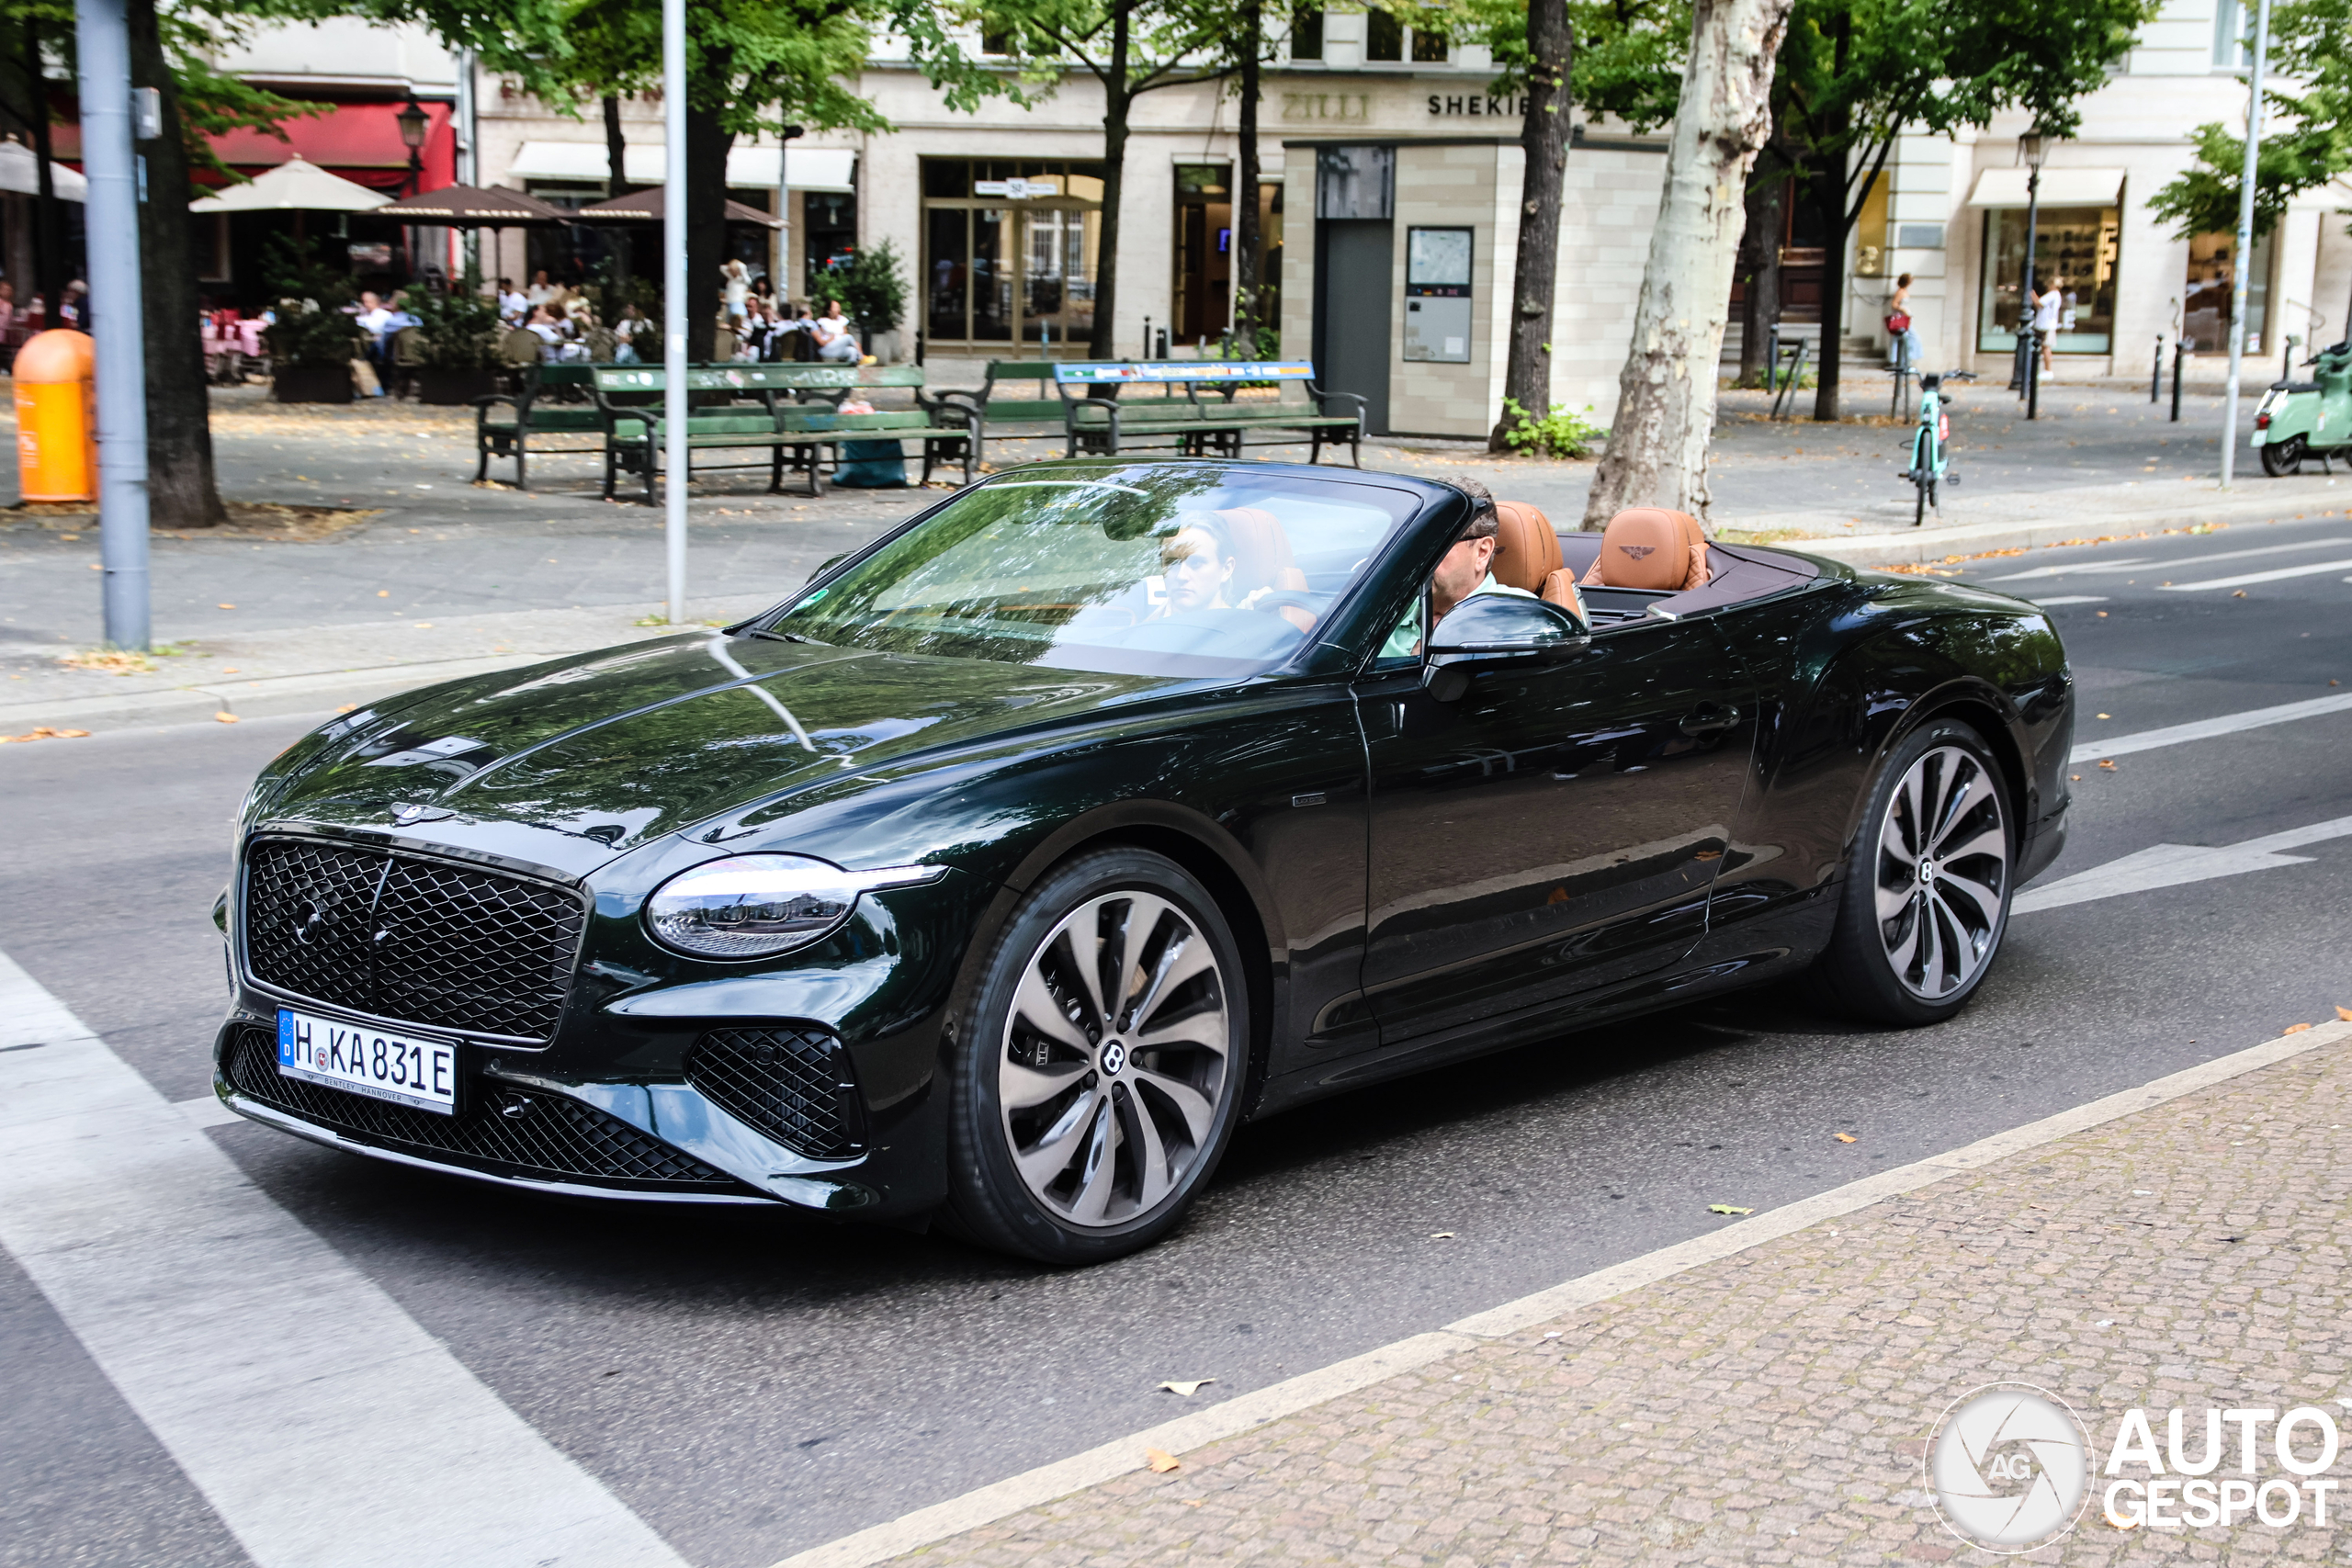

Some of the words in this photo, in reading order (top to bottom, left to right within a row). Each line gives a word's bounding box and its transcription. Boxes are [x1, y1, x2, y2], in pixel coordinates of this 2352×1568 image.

[1281, 93, 1370, 120] ZILLI
[1920, 861, 1933, 882] B
[284, 1043, 290, 1056] D
[295, 1020, 311, 1064] H
[1103, 1043, 1124, 1073] B
[324, 1077, 356, 1091] BENTLEY
[361, 1087, 401, 1102] HANNOVER
